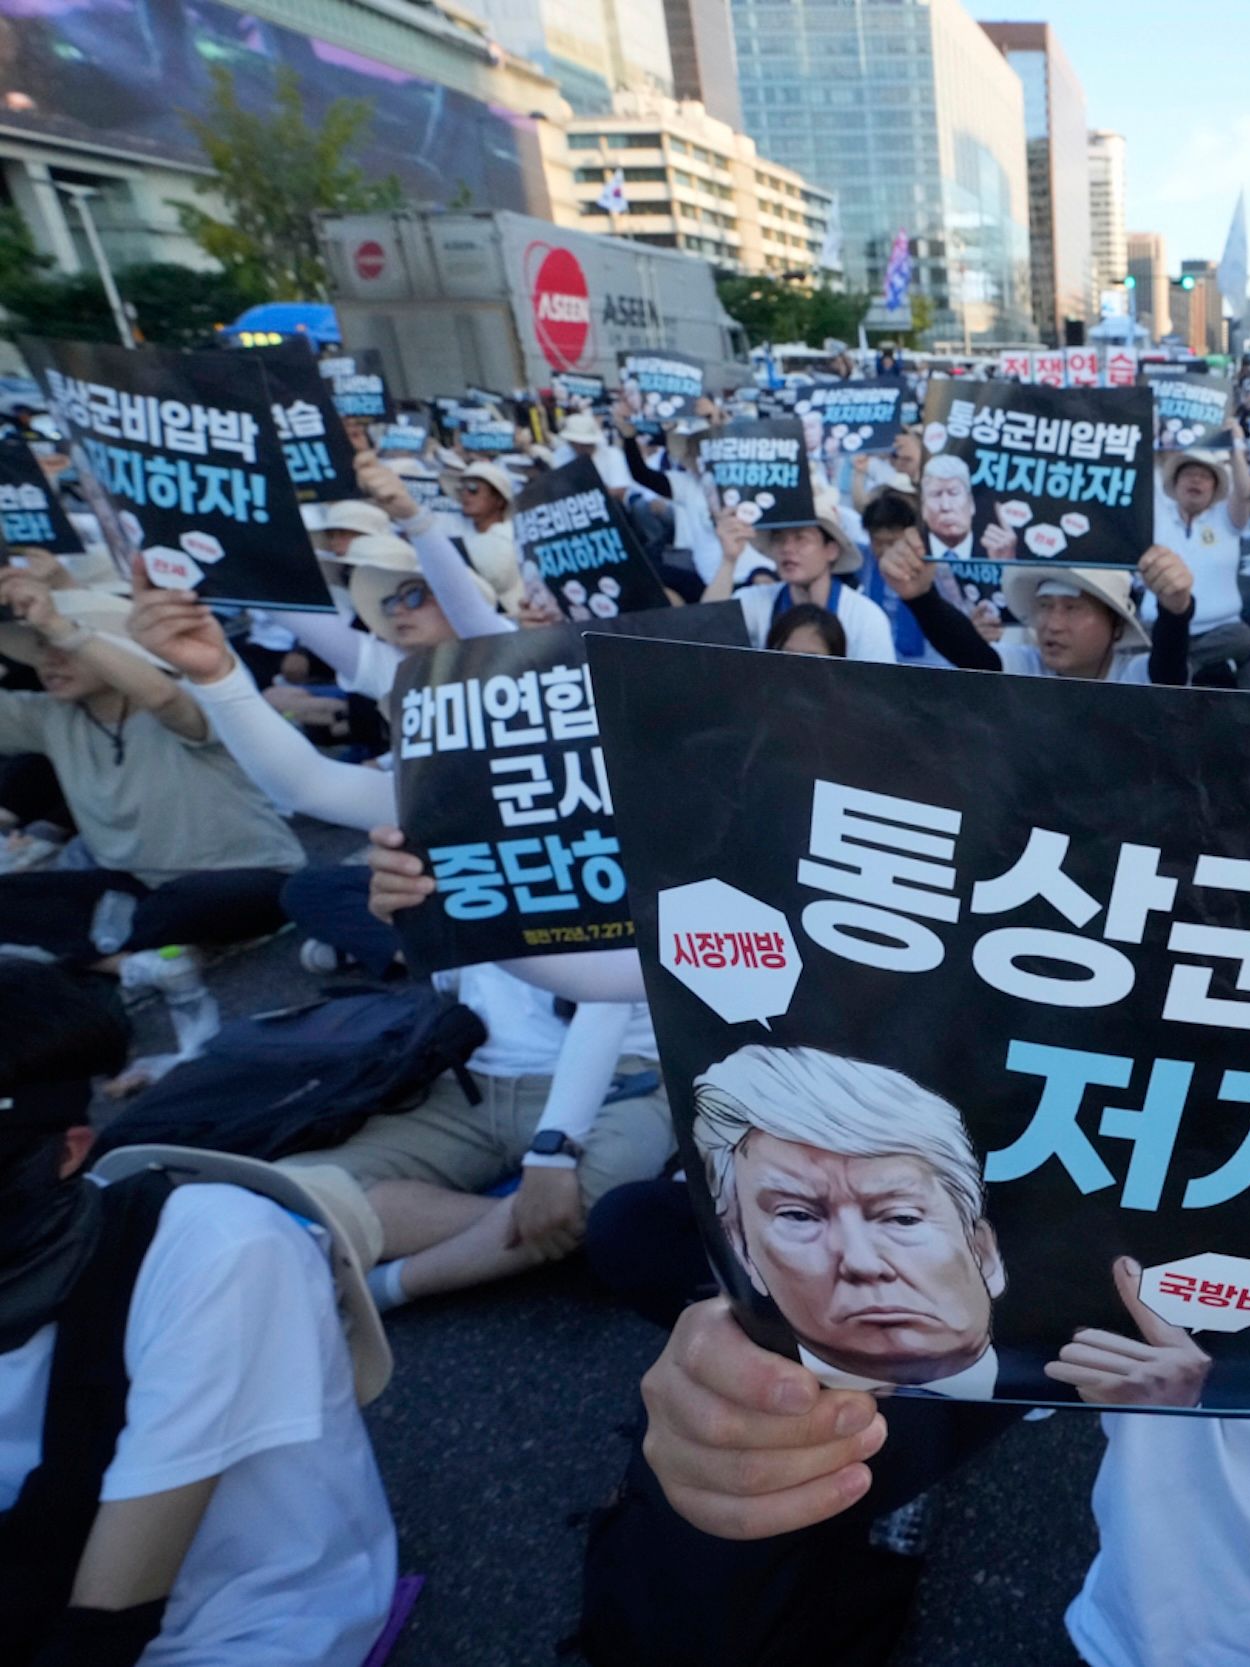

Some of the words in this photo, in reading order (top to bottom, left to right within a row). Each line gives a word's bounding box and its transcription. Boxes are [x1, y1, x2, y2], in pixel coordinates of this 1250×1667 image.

[947, 399, 1142, 462] 통상군비압박
[971, 449, 1137, 506] 저지하자!
[401, 663, 600, 761] 한미연합
[673, 931, 788, 971] 시장개방
